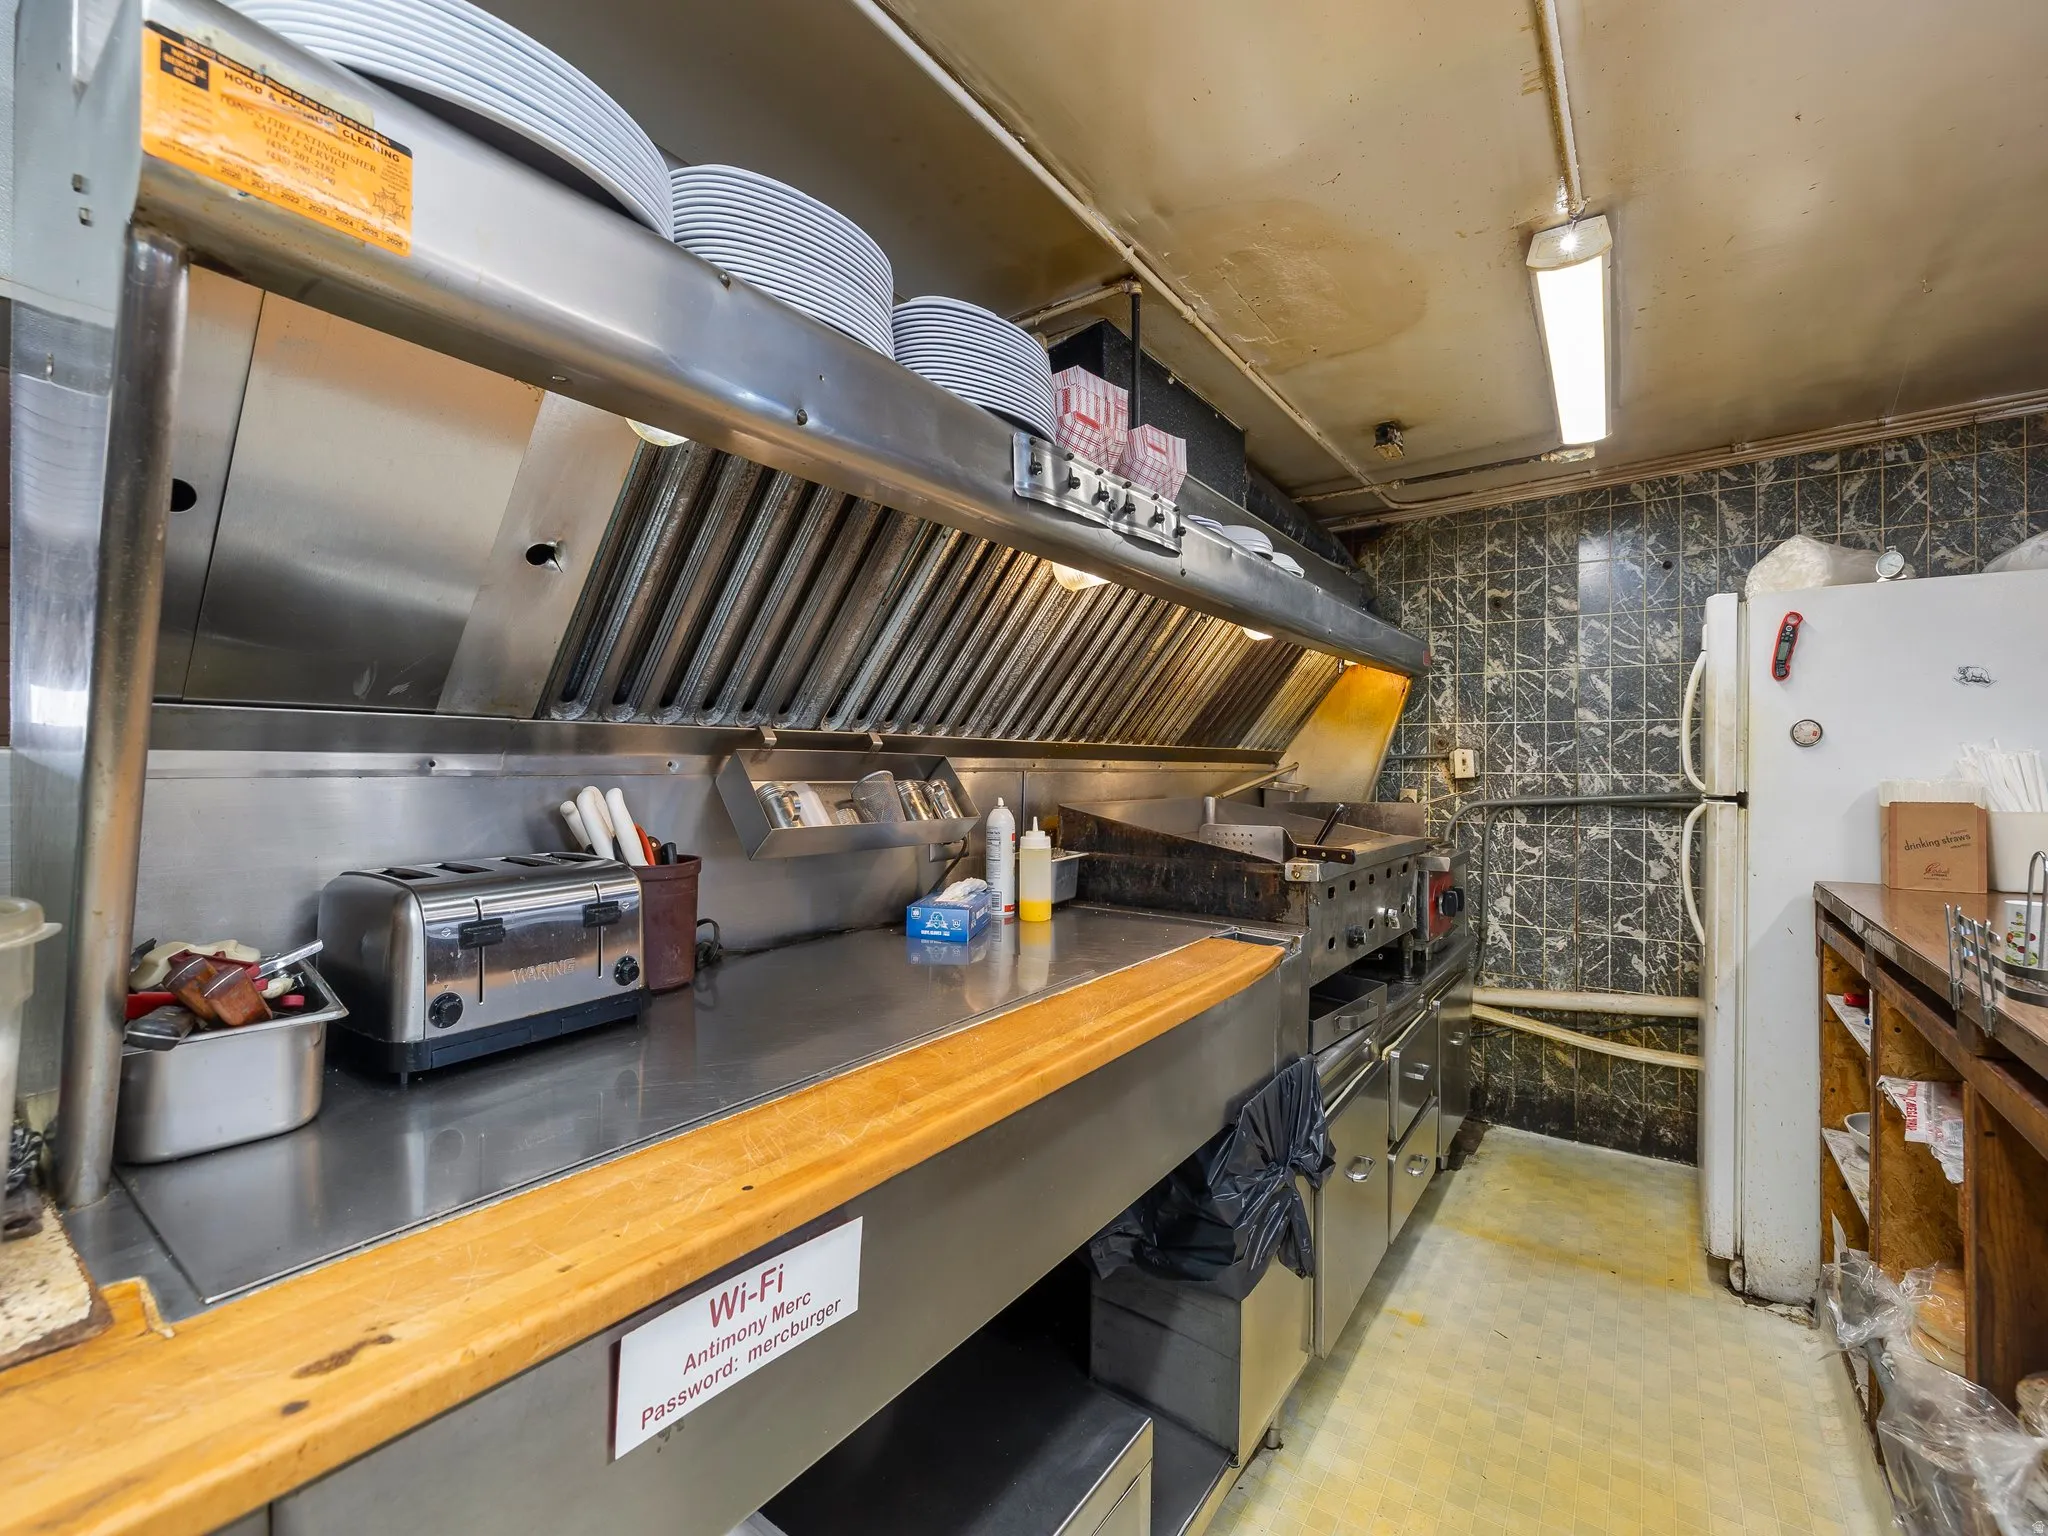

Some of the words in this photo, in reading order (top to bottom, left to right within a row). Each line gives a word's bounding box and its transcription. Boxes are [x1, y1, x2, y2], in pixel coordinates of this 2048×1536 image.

[224, 71, 263, 95] HOOD
[342, 129, 400, 162] CLEANING
[267, 116, 293, 135] FIRE
[295, 127, 377, 175] EXTINGUISHER
[303, 143, 348, 170] SERVICE
[280, 191, 300, 204] 2022
[308, 203, 328, 216] 2023
[335, 214, 354, 227] 2024
[1904, 837, 1941, 851] drinking
[1941, 834, 1972, 845] straws
[511, 957, 576, 985] WARING
[709, 1263, 785, 1328] Wi-Fi
[683, 1313, 767, 1376] Antimony
[771, 1291, 812, 1324] Merc
[641, 1357, 739, 1430] Password:
[748, 1298, 842, 1364] mercburger
